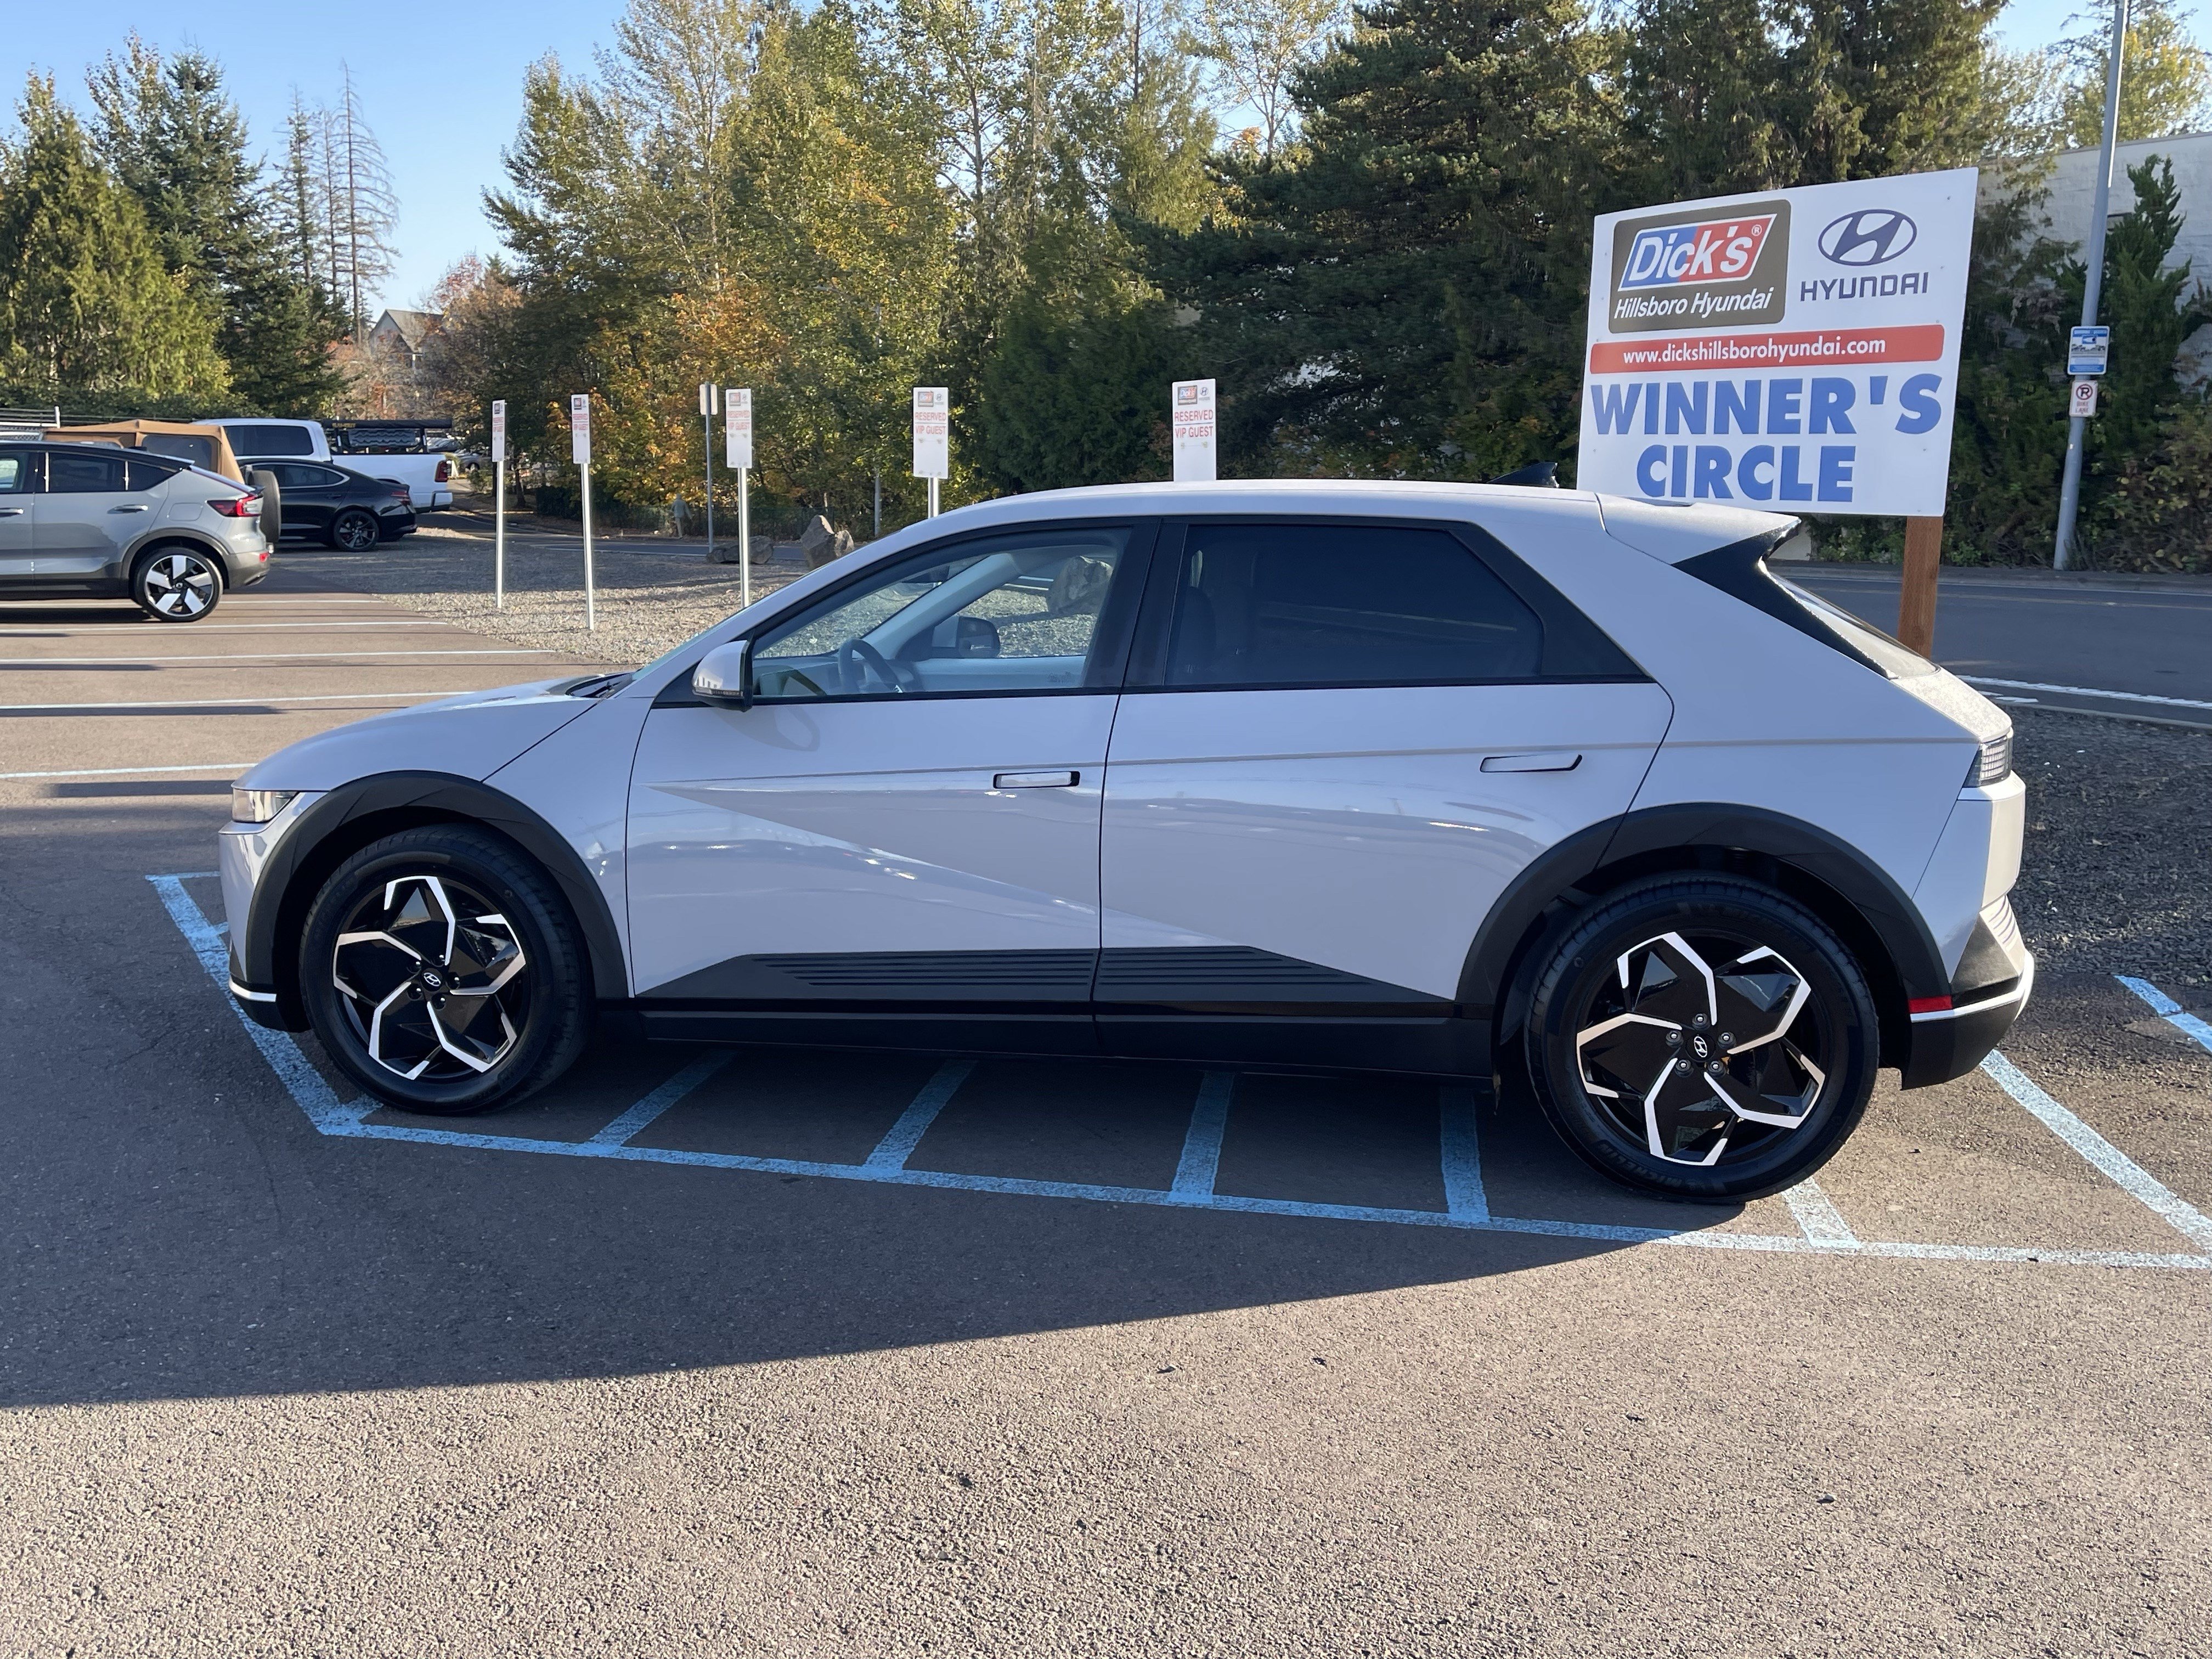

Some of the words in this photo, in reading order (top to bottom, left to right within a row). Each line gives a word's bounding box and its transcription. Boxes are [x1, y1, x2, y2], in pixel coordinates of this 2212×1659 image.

[1800, 272, 1929, 302] HYUNDAI
[1613, 296, 1688, 319] Hillsboro
[1690, 287, 1774, 318] Hyundai
[1623, 336, 1886, 363] www.dickshillsborohyundai.com
[915, 412, 946, 421] RESERVED
[1174, 410, 1214, 422] RESERVED
[1591, 373, 1943, 435] WINNER'S
[926, 426, 946, 435] GUEST
[1175, 427, 1187, 438] VIP
[1188, 426, 1214, 438] GUEST
[1637, 444, 1857, 503] CIRCLE
